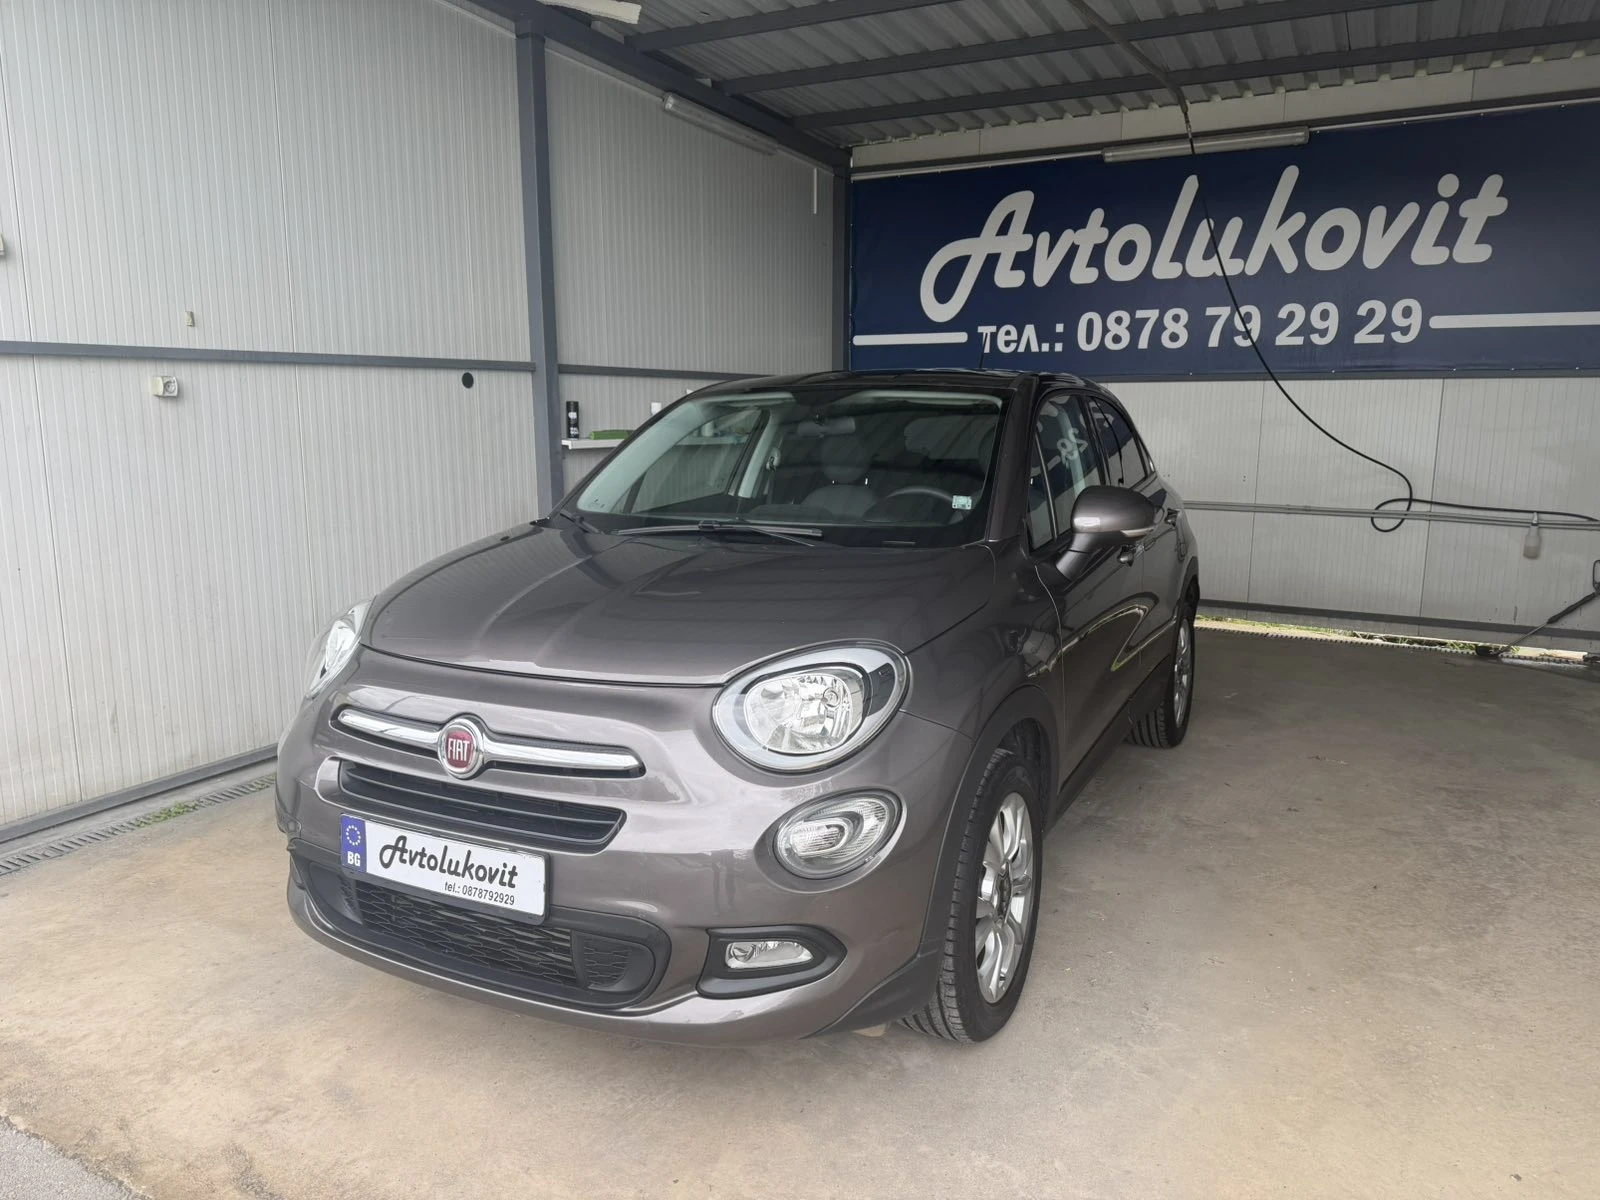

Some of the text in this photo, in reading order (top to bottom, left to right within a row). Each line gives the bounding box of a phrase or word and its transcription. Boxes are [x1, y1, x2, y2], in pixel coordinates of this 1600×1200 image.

[920, 165, 1509, 323] Avtolukovit
[978, 298, 1423, 353] тел.: 0878 79 29 29
[448, 738, 470, 761] FIAT
[347, 851, 361, 867] BG
[380, 836, 518, 888] Avtolukovit
[444, 881, 515, 906] tel.: 0878792929
